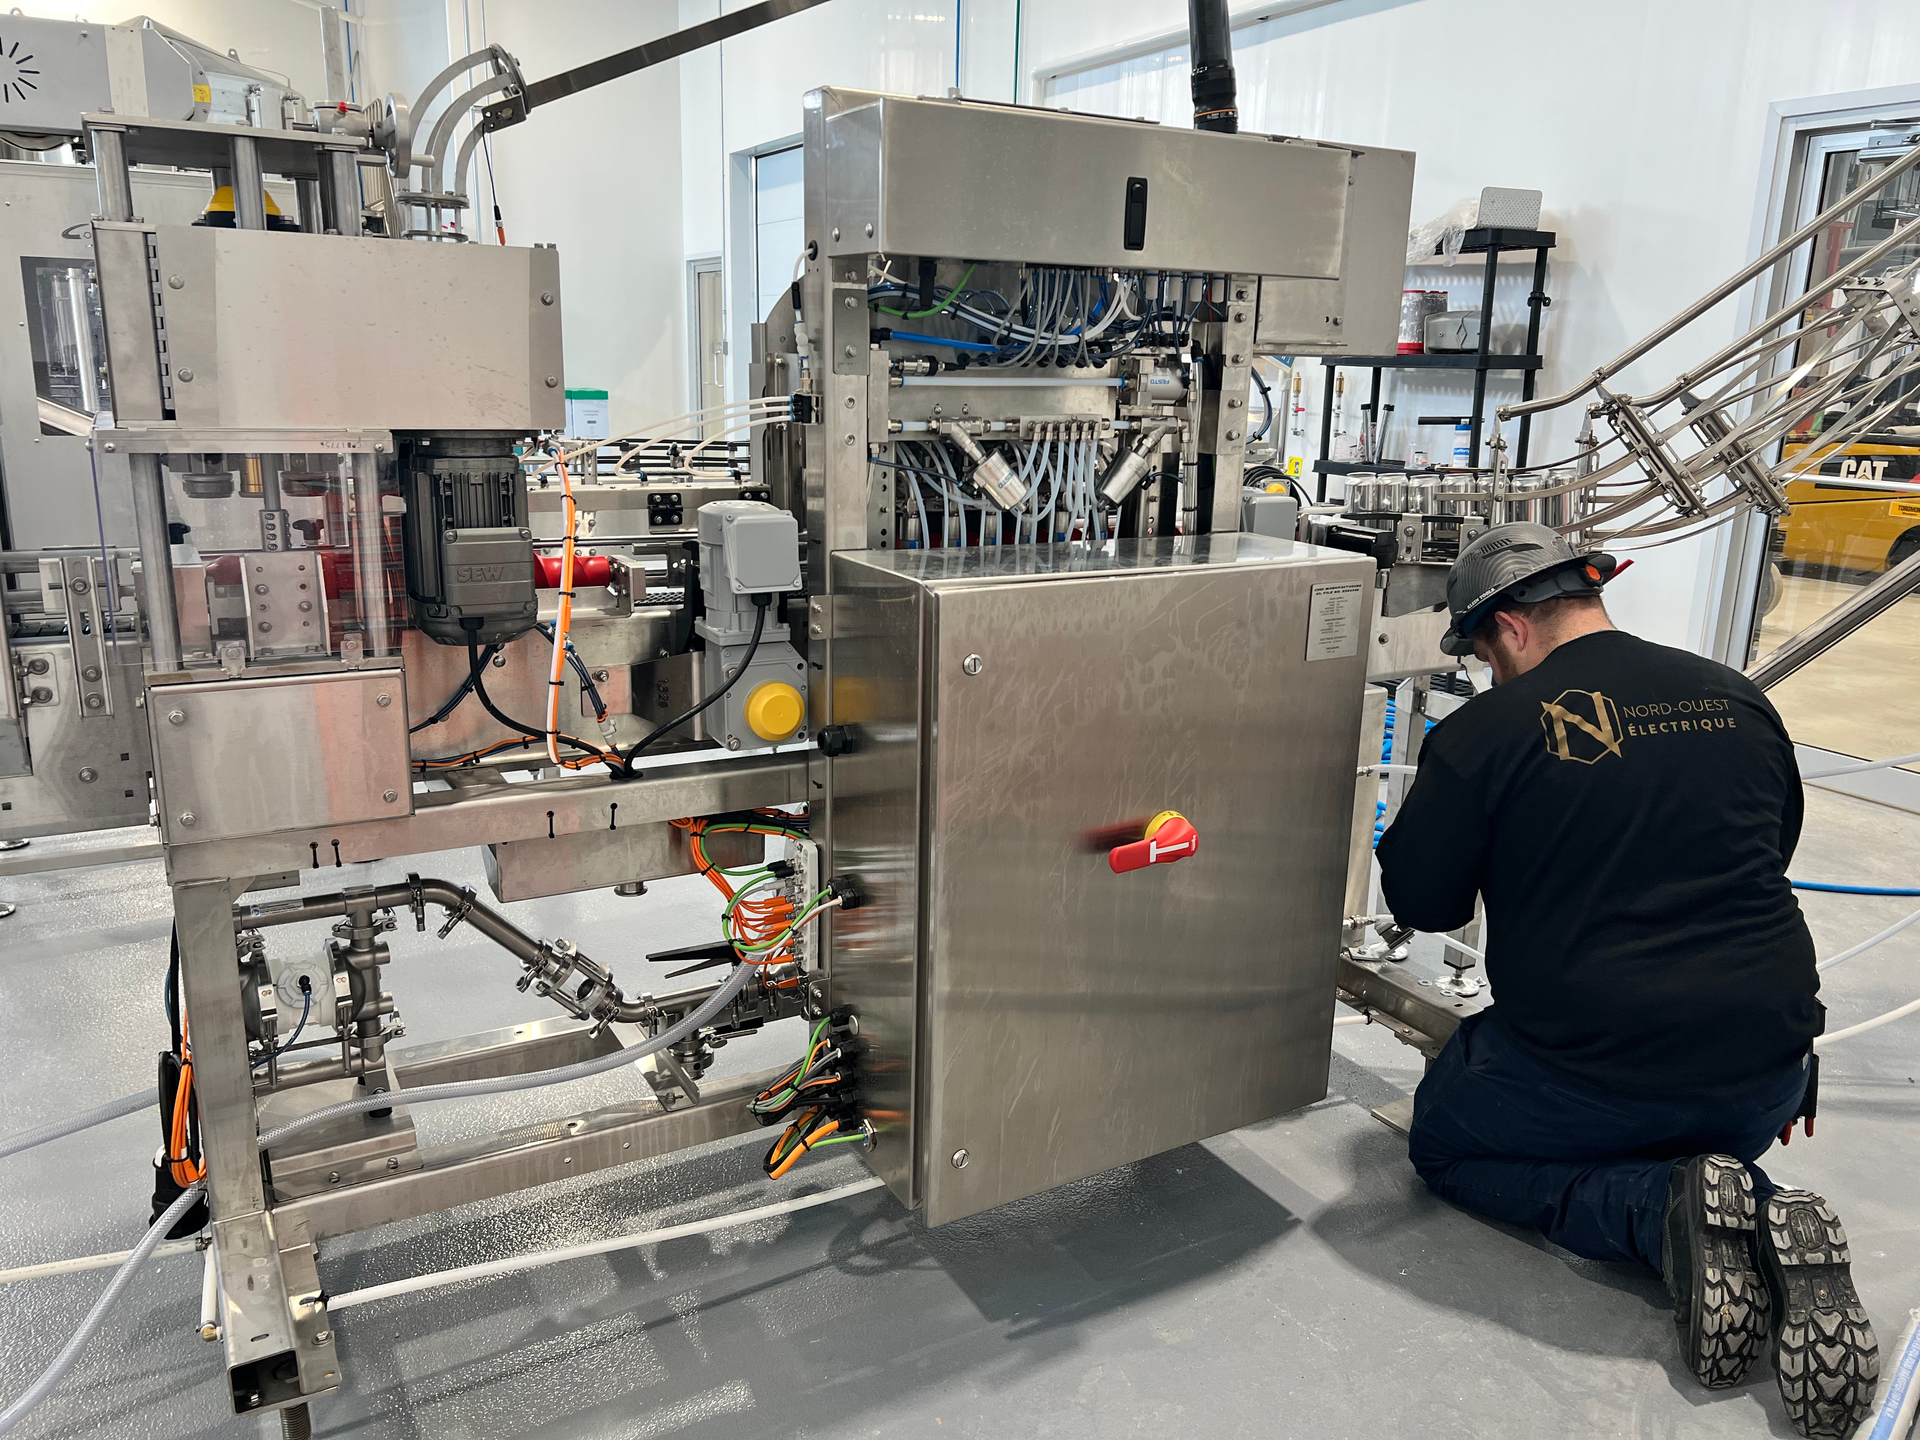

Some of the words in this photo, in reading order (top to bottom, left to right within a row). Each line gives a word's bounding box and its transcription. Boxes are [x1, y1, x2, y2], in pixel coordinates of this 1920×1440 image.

[1840, 459, 1889, 481] CAT
[456, 565, 505, 583] SEW
[1623, 699, 1730, 719] NORD-OUEST
[1627, 717, 1736, 737] ÉLECTRIQUE
